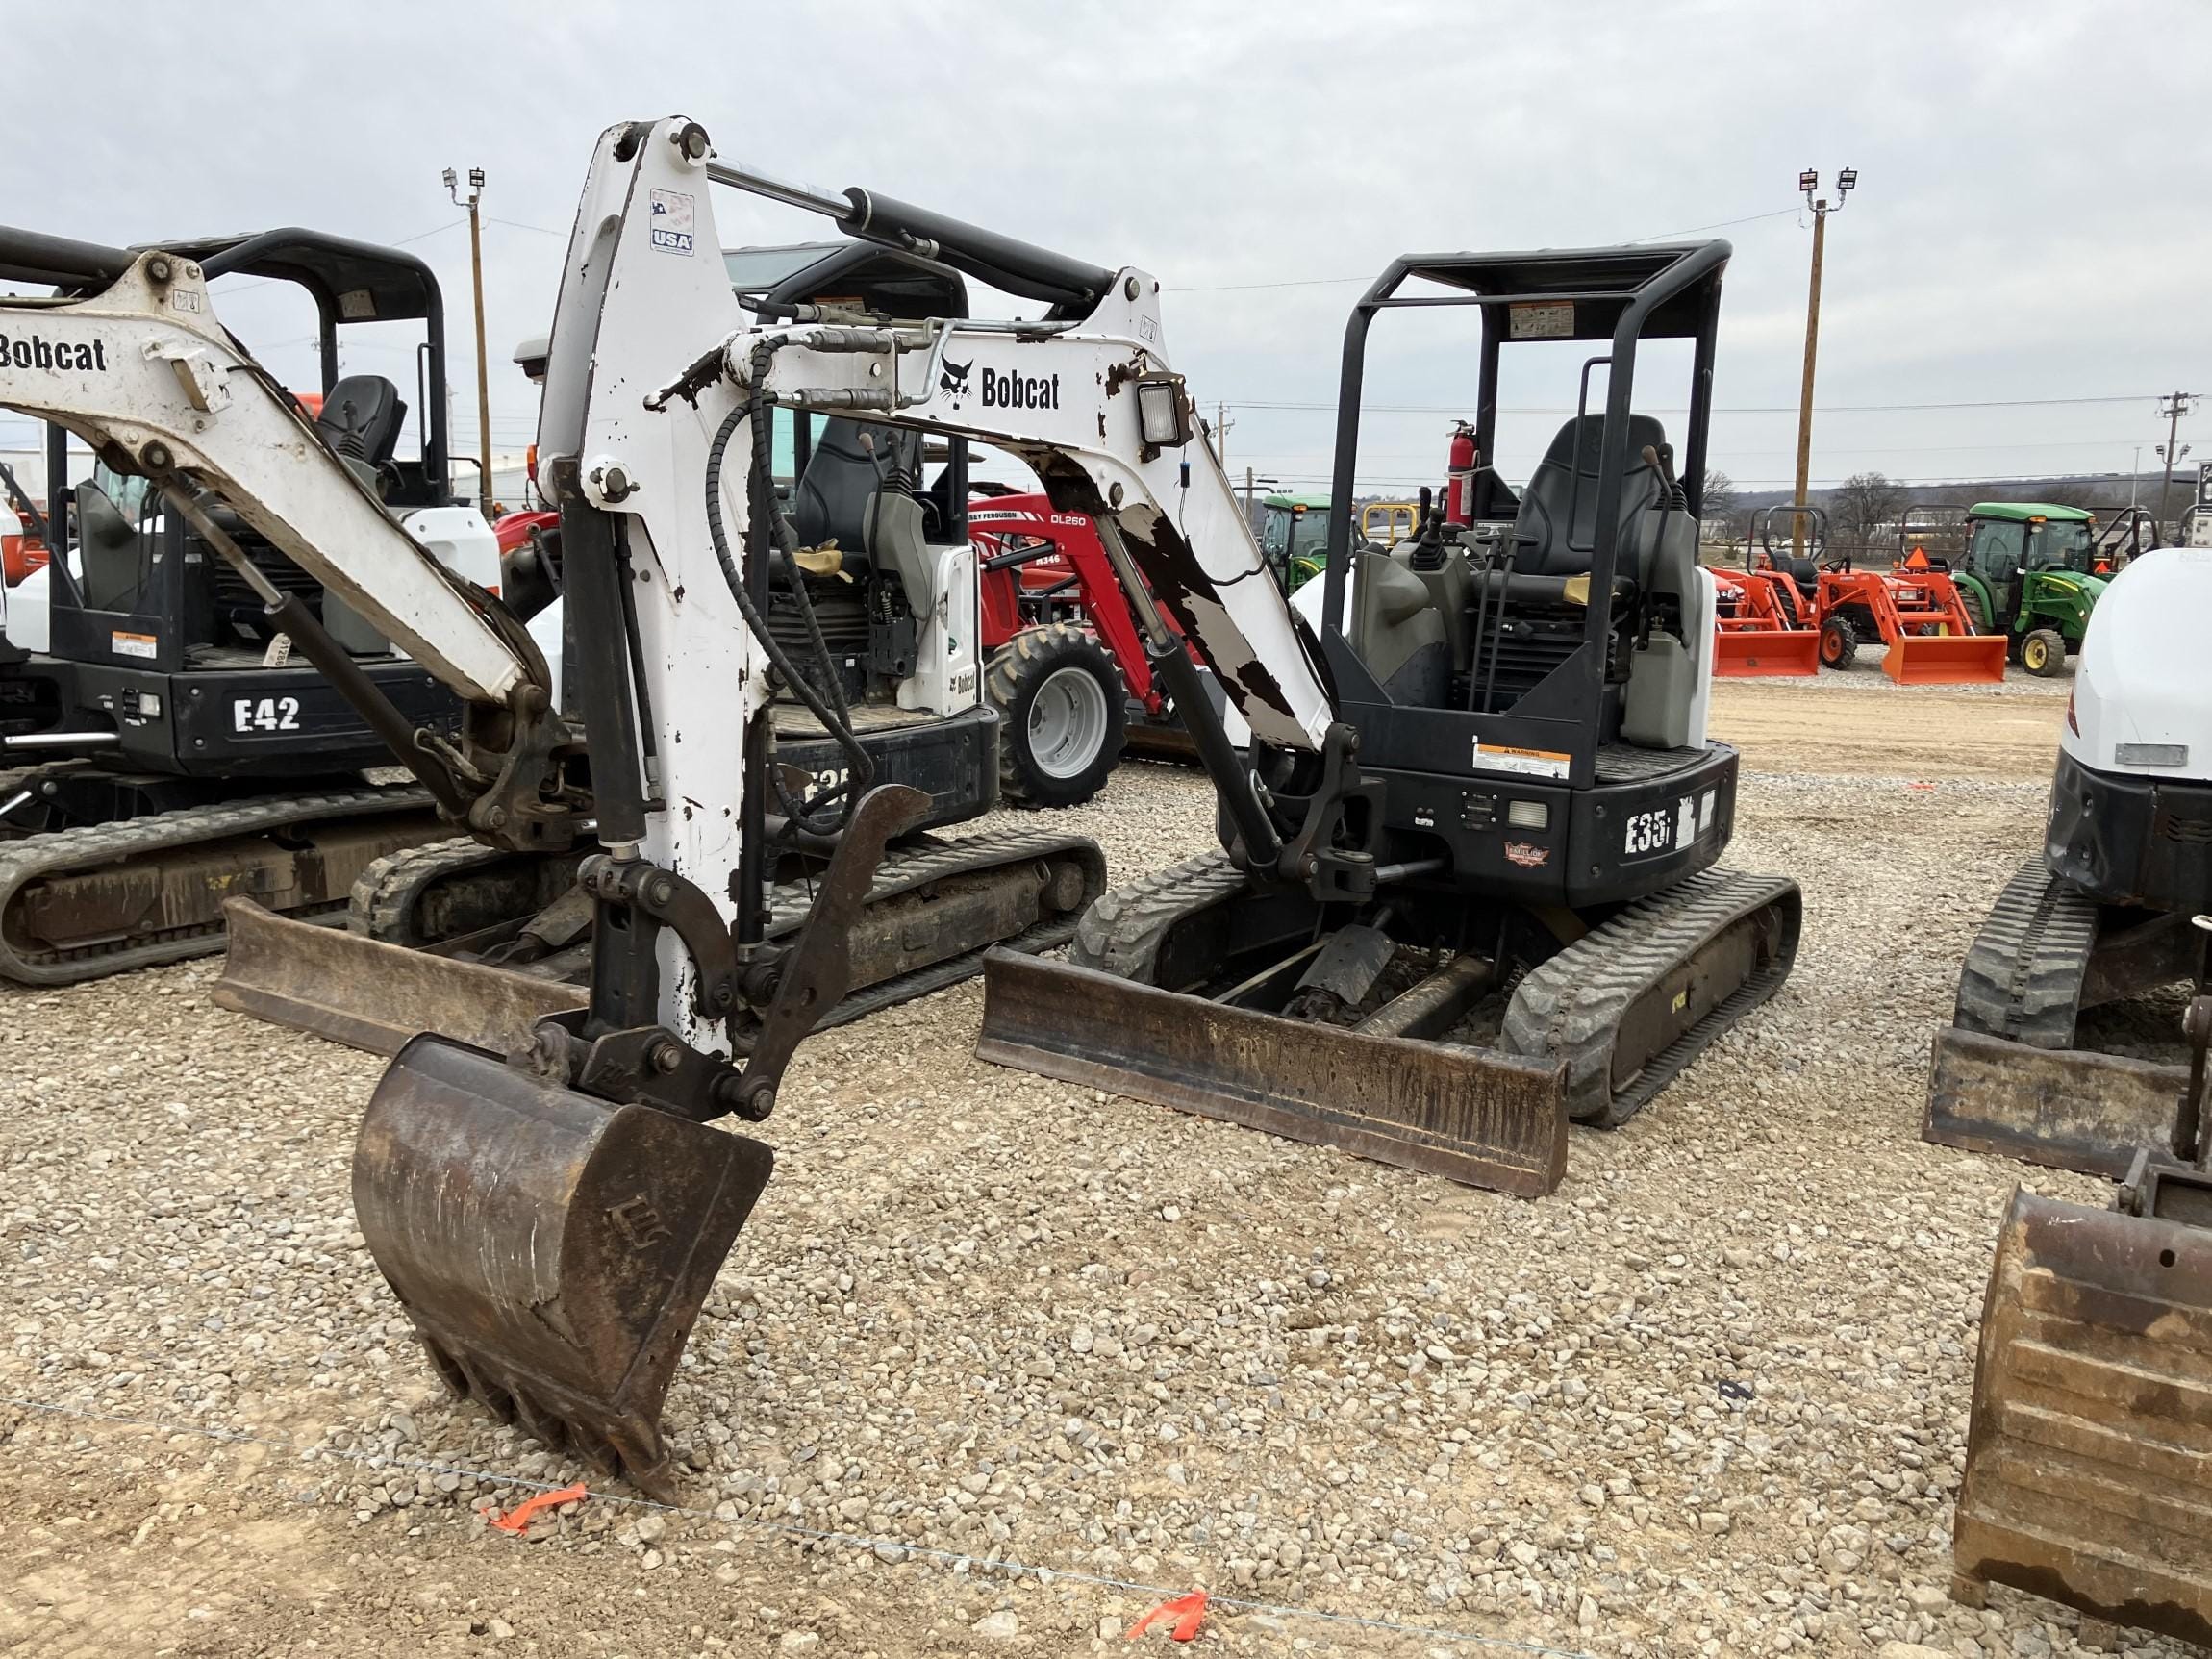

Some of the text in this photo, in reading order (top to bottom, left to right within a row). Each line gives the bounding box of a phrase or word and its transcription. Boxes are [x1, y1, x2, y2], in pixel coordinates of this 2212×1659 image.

[653, 231, 691, 249] USA
[0, 334, 106, 372] Bobcat
[982, 367, 1059, 410] Bobcat
[1050, 515, 1086, 527] DL260
[234, 697, 300, 732] E42
